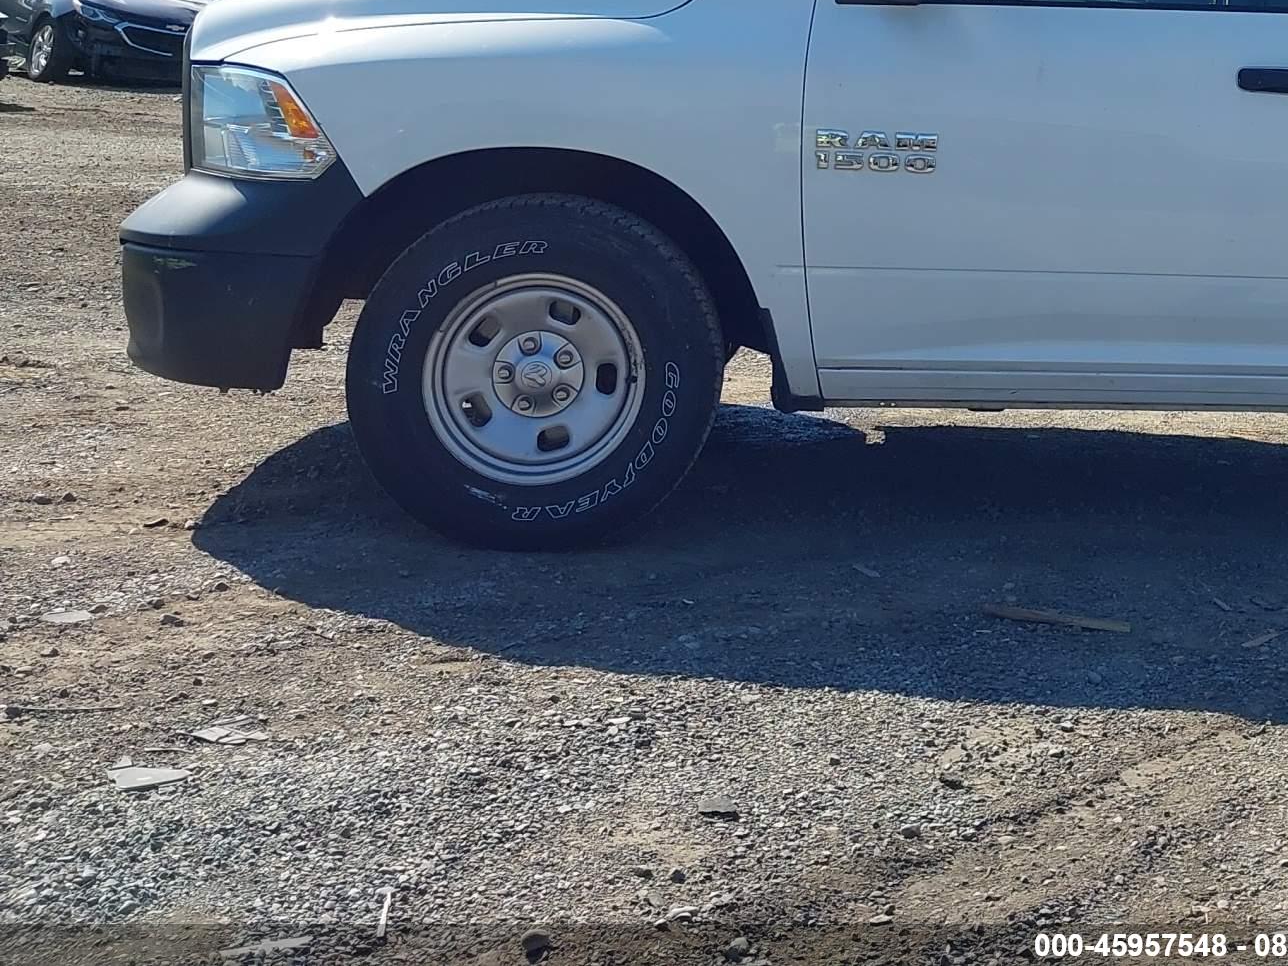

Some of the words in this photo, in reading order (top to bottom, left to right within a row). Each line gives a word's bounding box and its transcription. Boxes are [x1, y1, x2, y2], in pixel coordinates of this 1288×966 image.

[815, 150, 937, 174] 1500
[816, 129, 939, 152] RAM
[382, 240, 549, 394] WRANGLER
[511, 361, 680, 521] GOODYEAR
